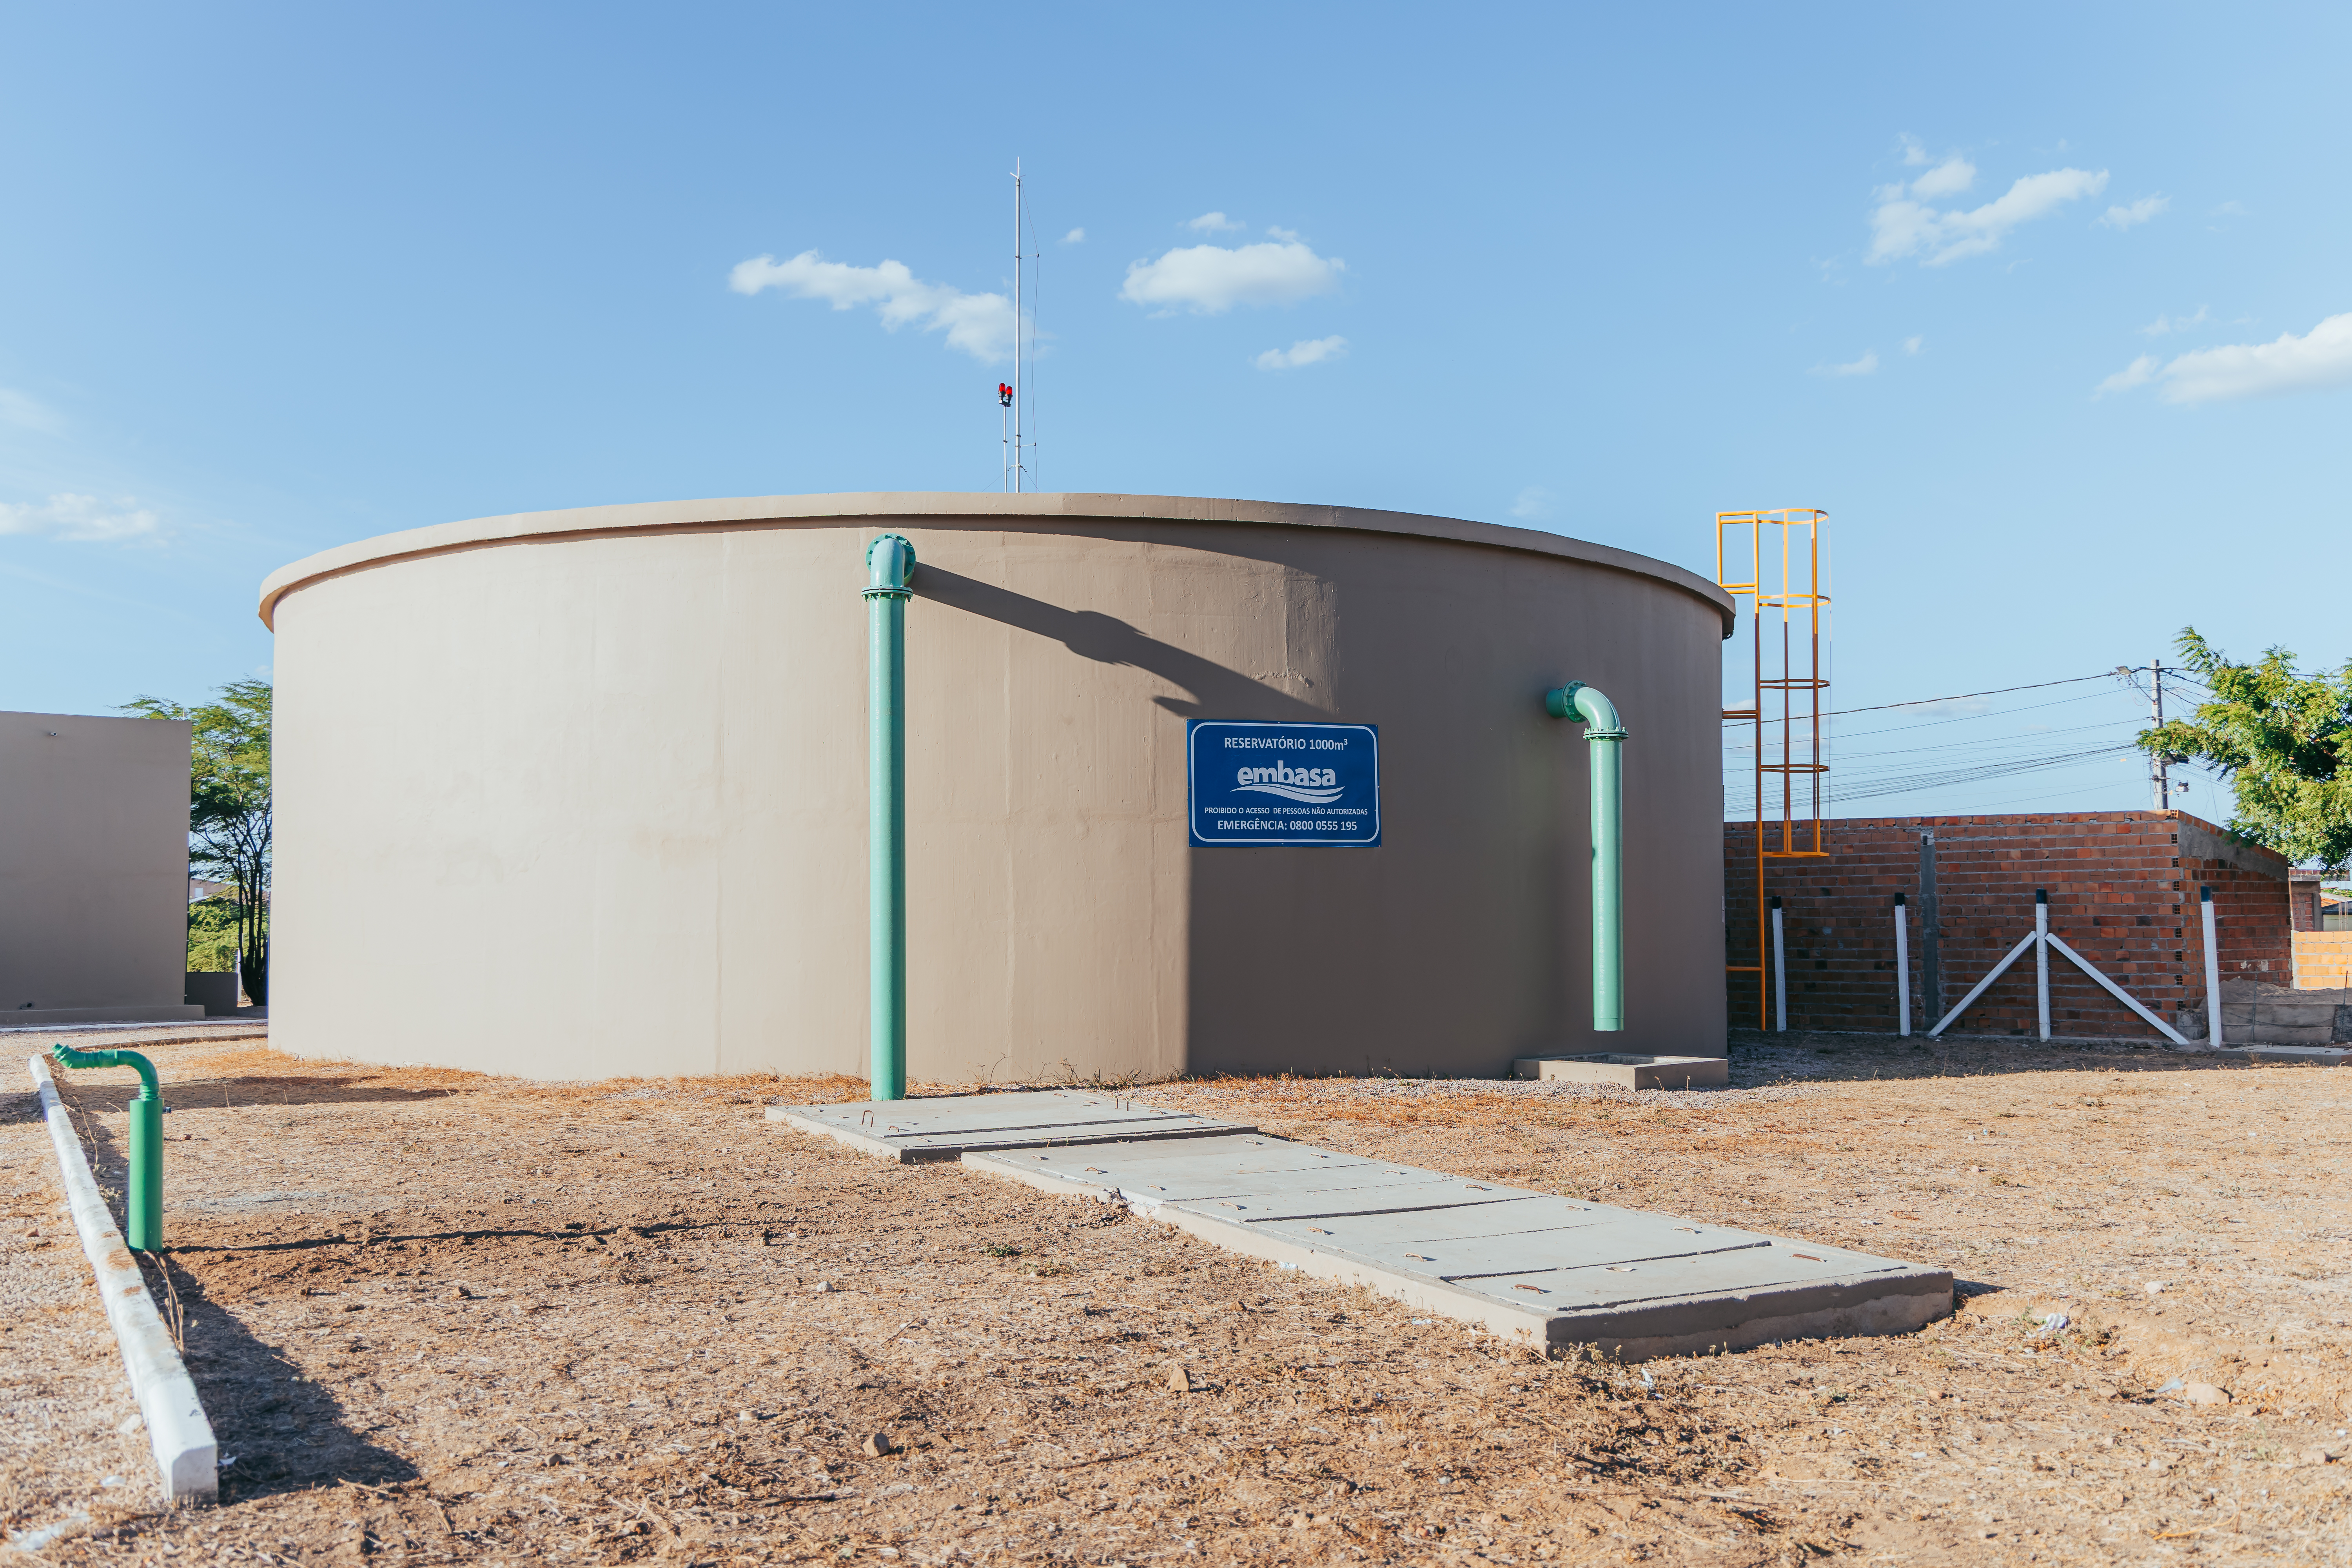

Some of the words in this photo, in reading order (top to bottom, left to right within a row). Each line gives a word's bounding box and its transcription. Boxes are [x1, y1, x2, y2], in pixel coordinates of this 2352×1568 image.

[1225, 736, 1306, 749] RESERVATÓRIO
[1309, 739, 1348, 750] 1000m³
[1237, 760, 1336, 786] embasa
[1218, 818, 1287, 830] EMERGÊNCIA:
[1290, 820, 1313, 830] 0800
[1316, 820, 1338, 830] 0555
[1341, 821, 1357, 831] 195
